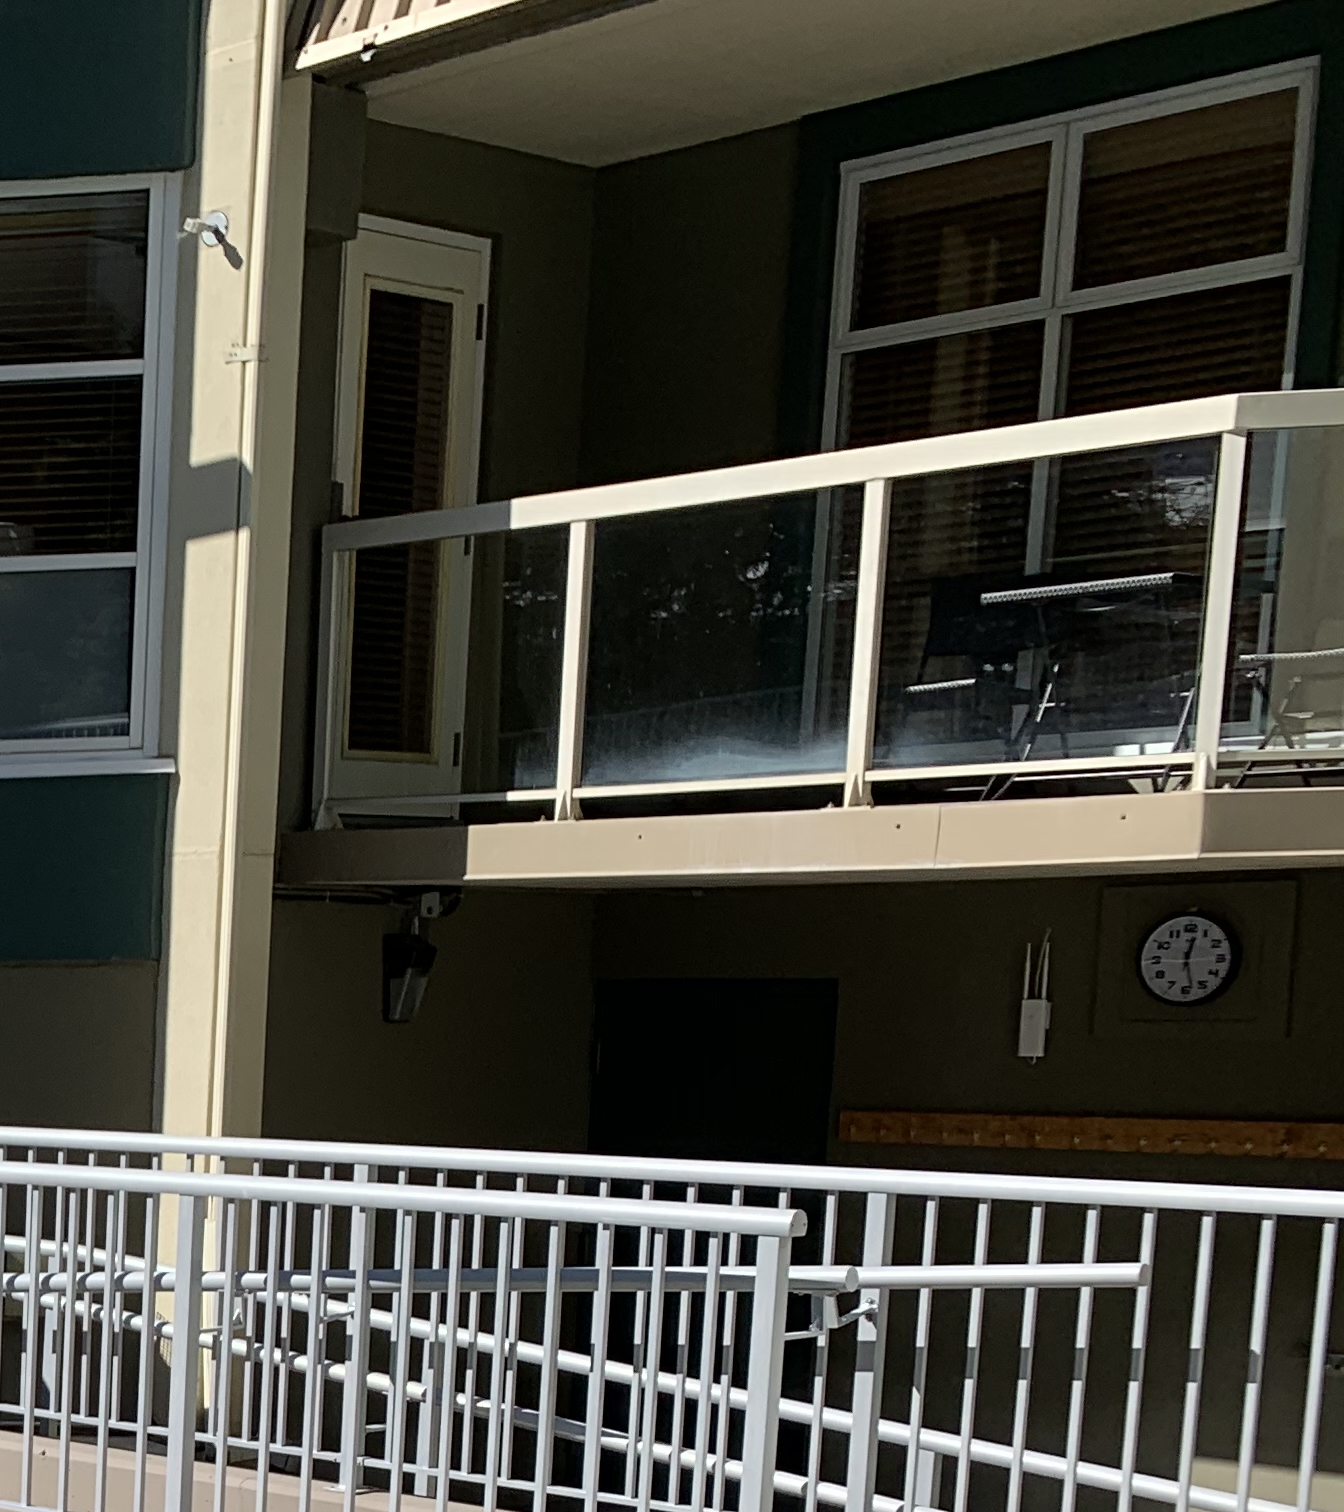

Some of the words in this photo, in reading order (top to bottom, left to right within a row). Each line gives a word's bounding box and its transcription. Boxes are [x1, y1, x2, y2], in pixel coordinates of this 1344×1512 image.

[1169, 929, 1181, 939] 11
[1203, 929, 1209, 938] 1
[1211, 939, 1222, 948] 2
[1167, 980, 1177, 990] 7
[1197, 980, 1208, 989] 5
[1181, 985, 1192, 995] 6
